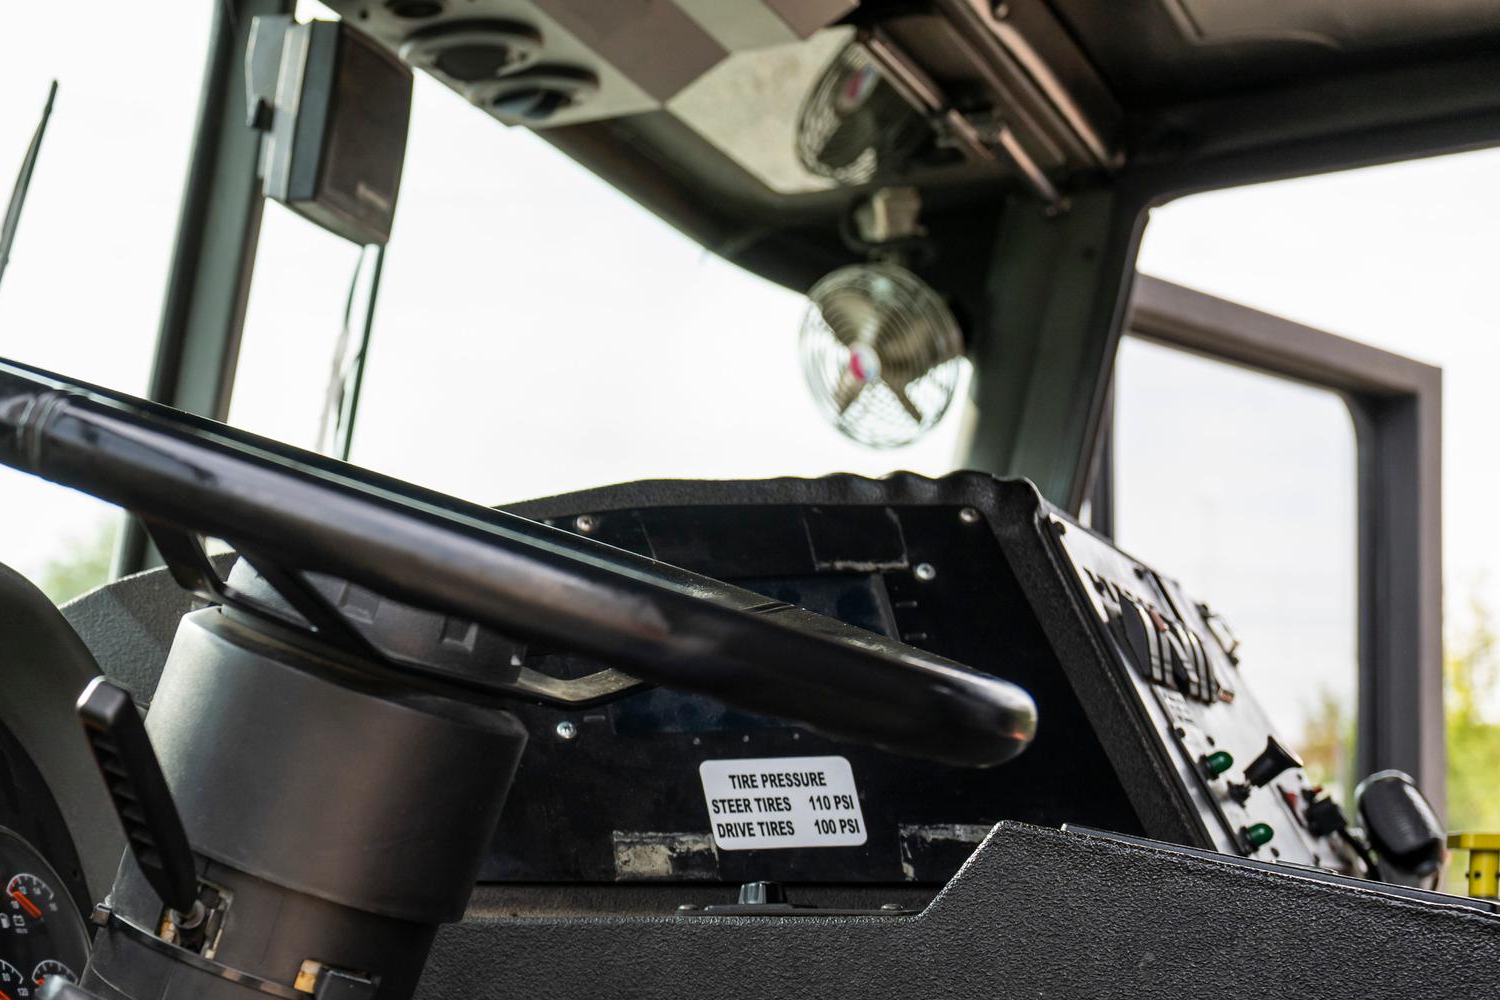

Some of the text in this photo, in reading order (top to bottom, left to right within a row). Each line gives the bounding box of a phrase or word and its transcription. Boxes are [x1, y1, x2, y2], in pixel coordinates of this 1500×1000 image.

[728, 772, 826, 790] TIRE PRESSURE
[712, 794, 854, 814] STEER TIRES 110 PSI
[717, 818, 860, 838] DRIVE TIRES 100 PSI
